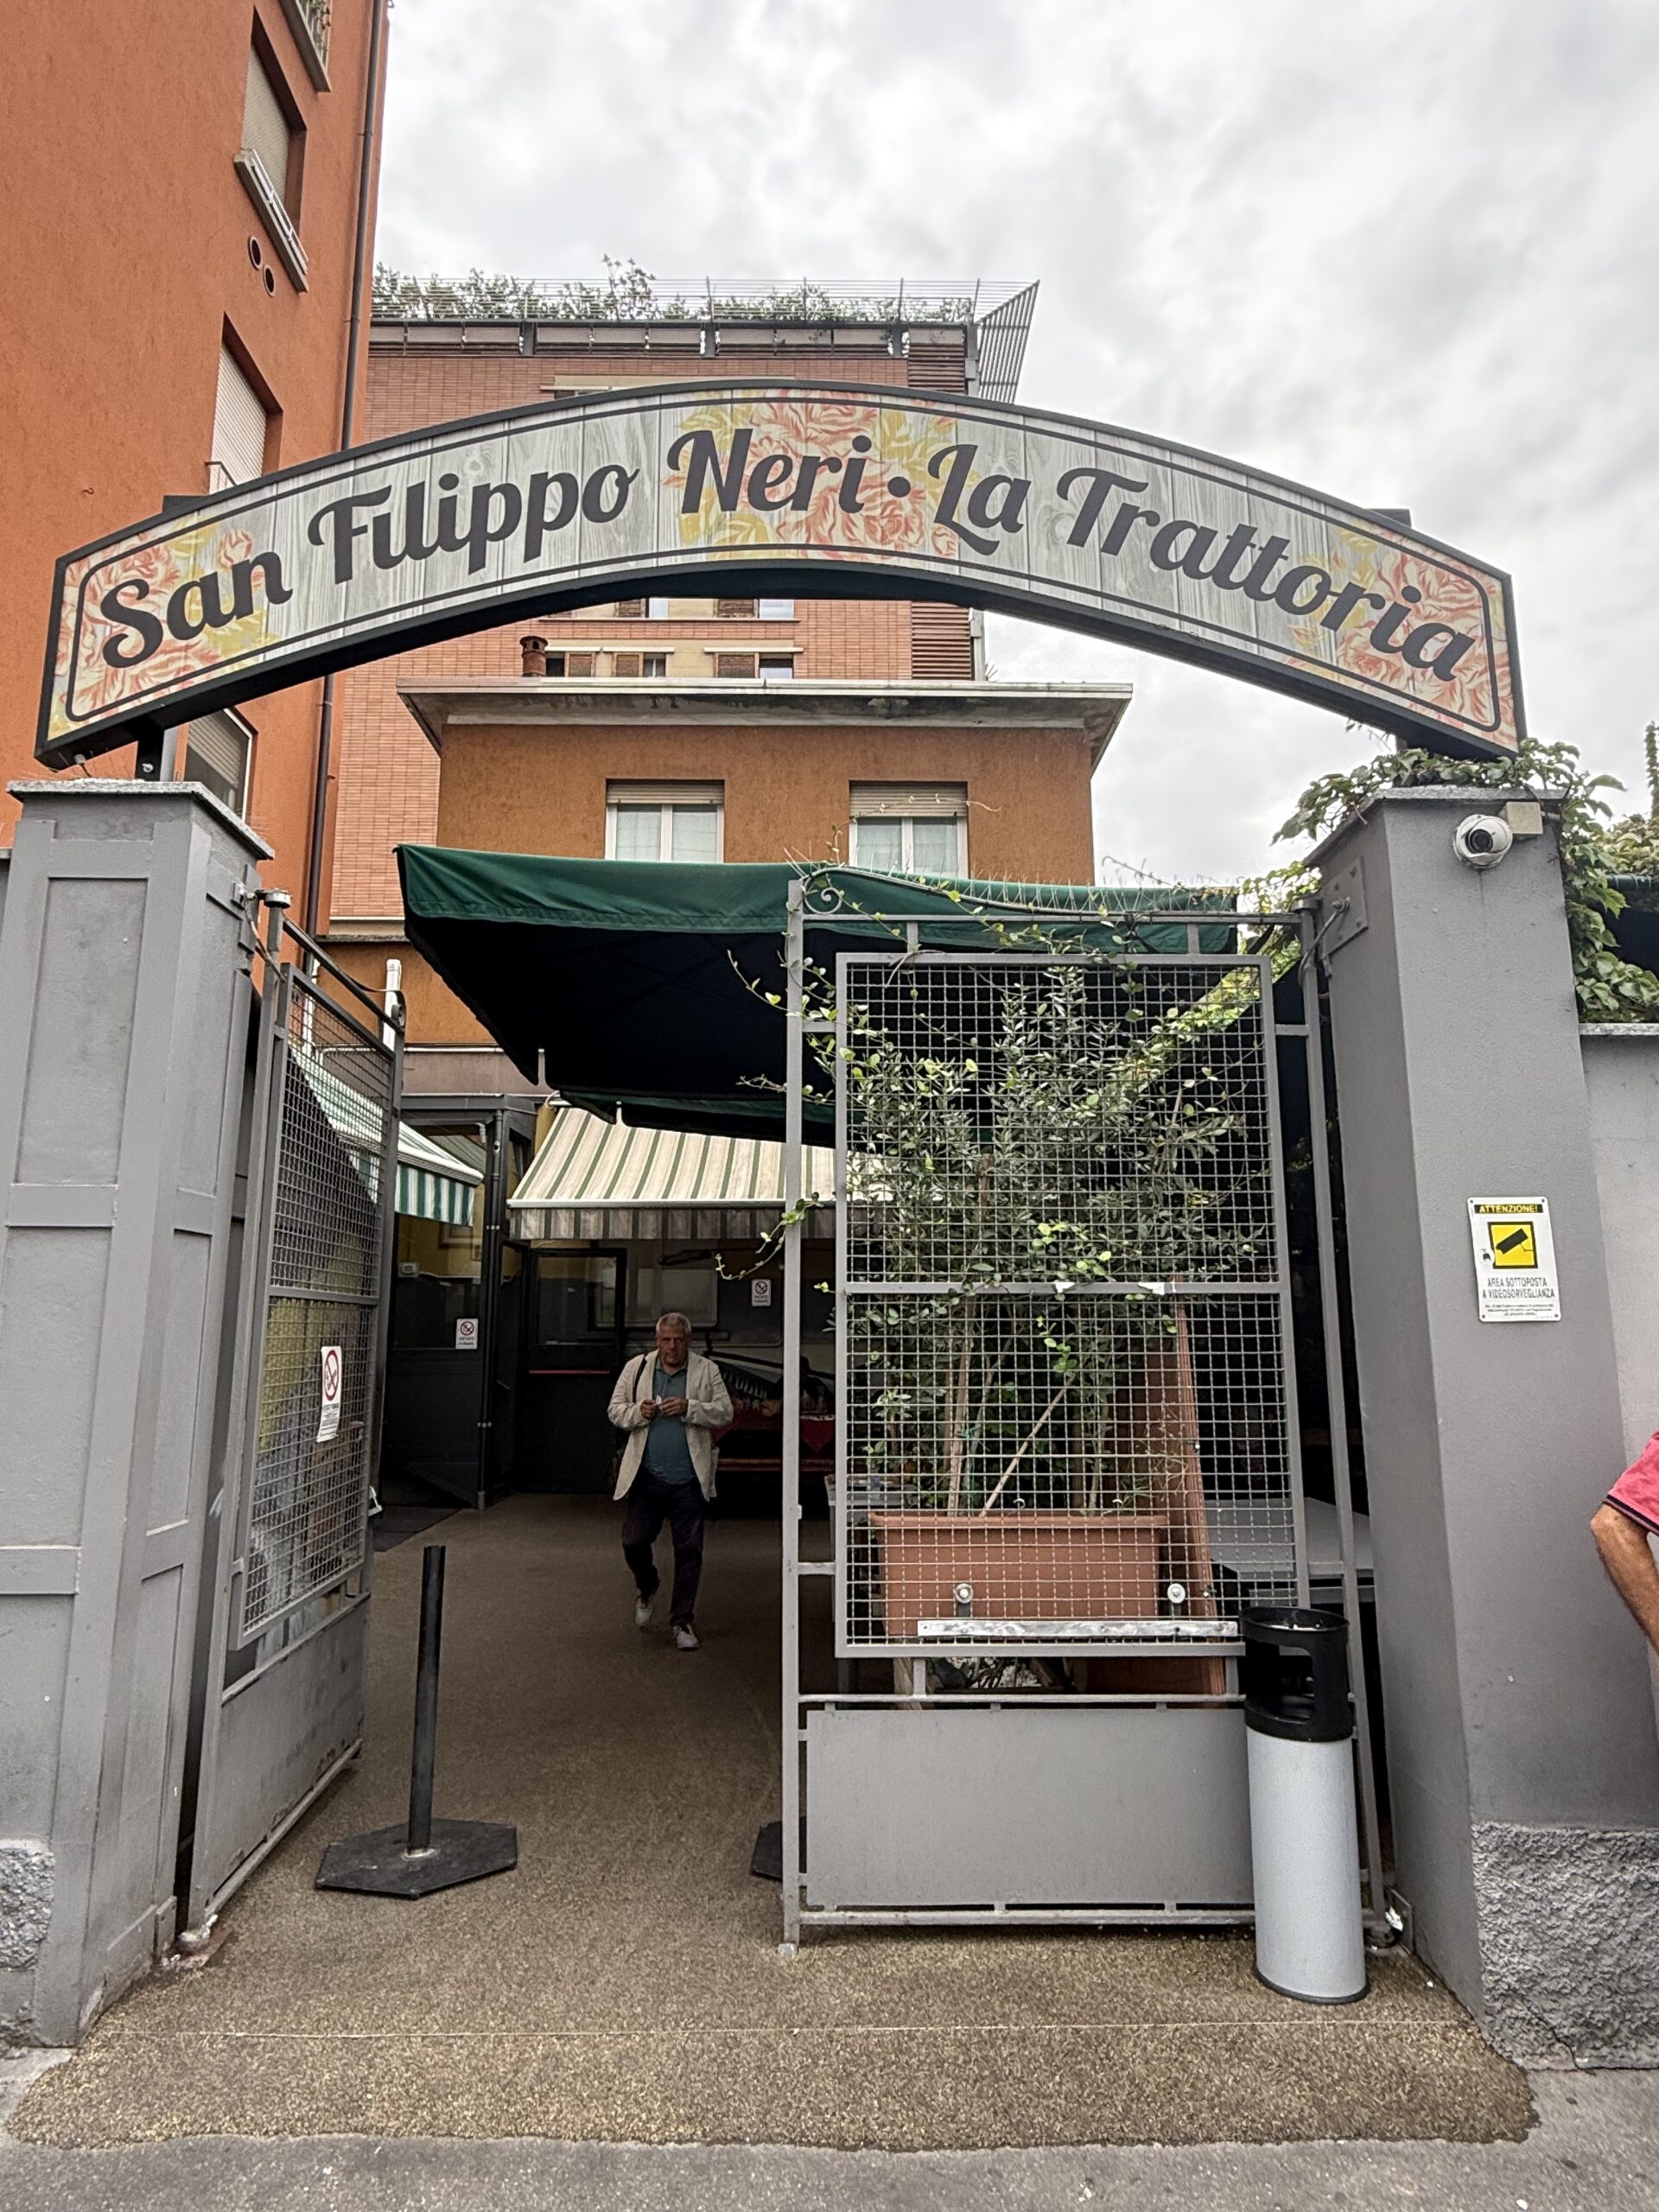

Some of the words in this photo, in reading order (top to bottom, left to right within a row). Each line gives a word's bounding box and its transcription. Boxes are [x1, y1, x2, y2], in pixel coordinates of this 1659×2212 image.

[99, 548, 293, 669] San
[307, 463, 639, 585] Filippo
[667, 428, 873, 514] Neri
[927, 443, 1032, 556] La
[1056, 467, 1476, 681] Trattoria
[1478, 1204, 1538, 1213] ATTENZIONE!
[1487, 1277, 1504, 1287] AREA
[1505, 1276, 1548, 1287] SOTTOPOSTA
[1482, 1288, 1487, 1299] A
[1488, 1287, 1556, 1299] VIDEOSORVEGLIANZA
